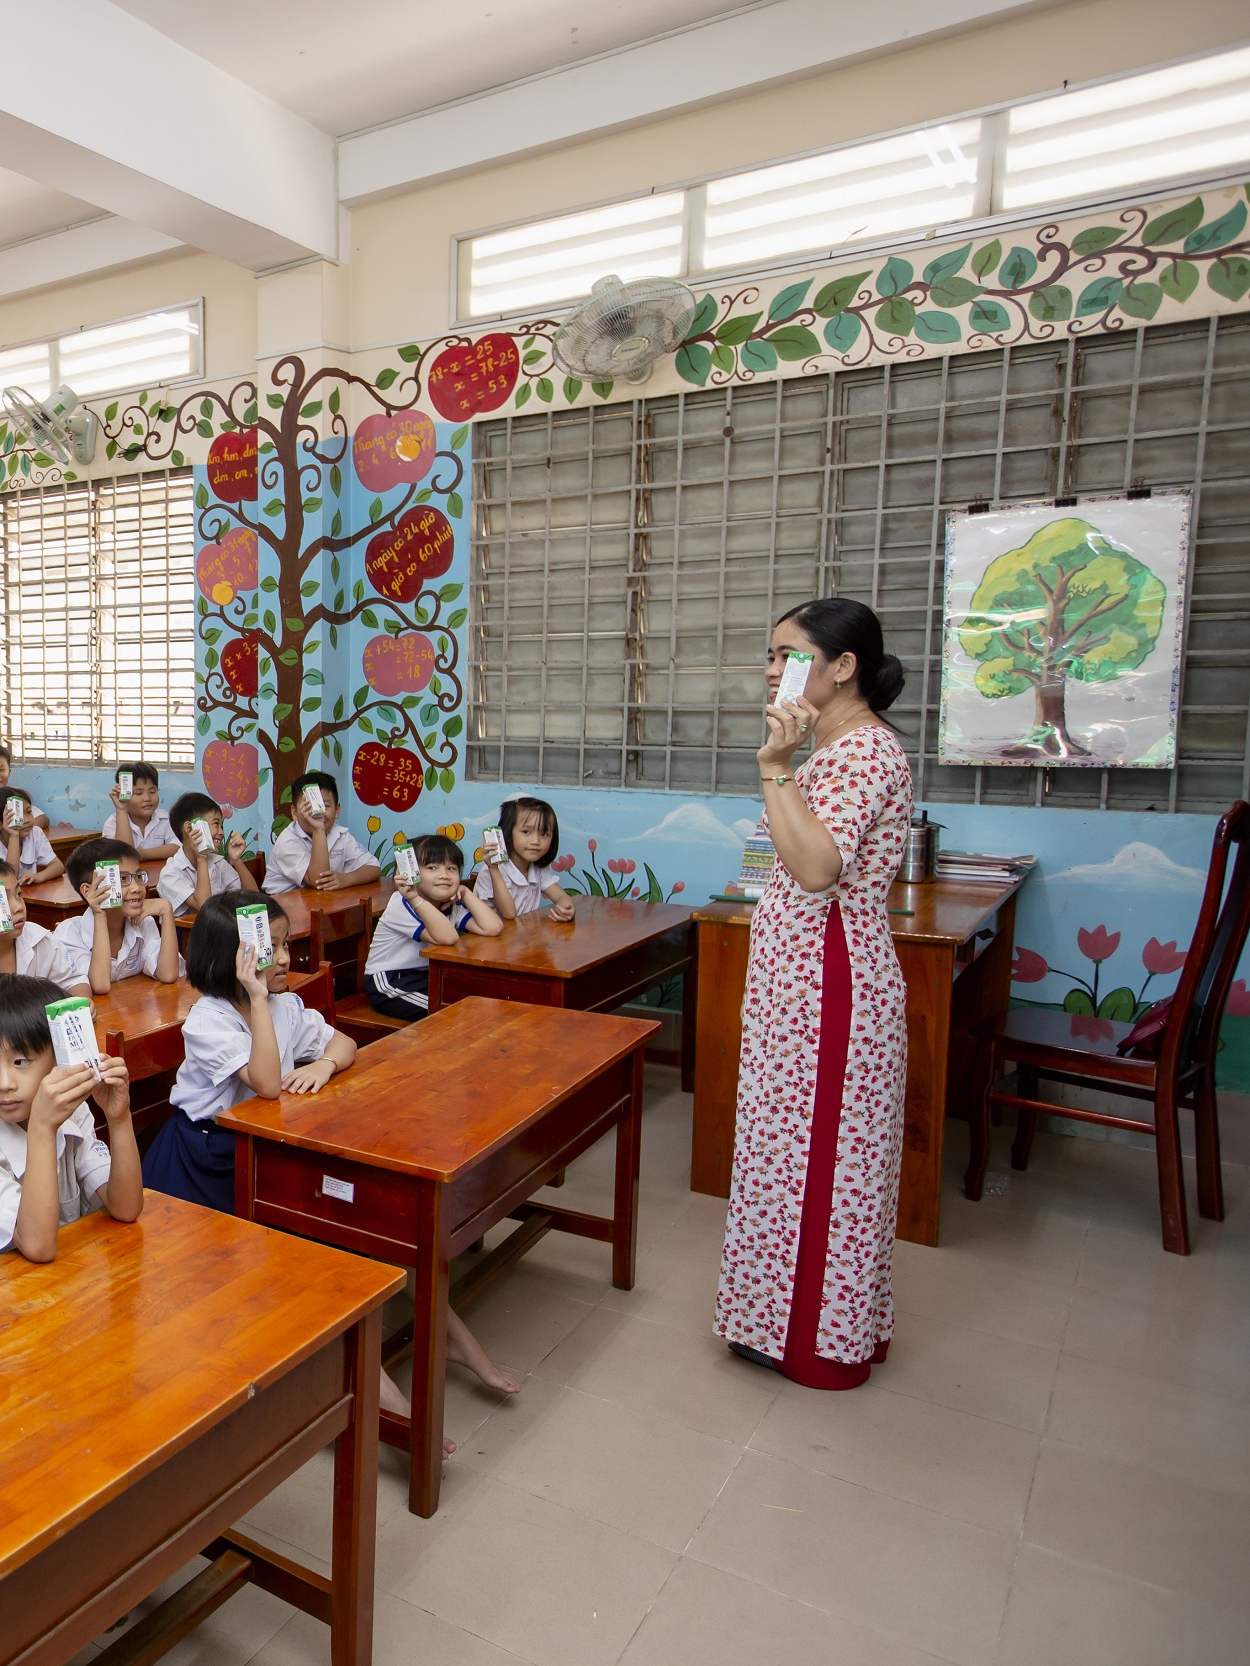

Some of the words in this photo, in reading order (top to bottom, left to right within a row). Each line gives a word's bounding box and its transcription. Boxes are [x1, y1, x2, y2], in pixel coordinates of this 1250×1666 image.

[476, 340, 493, 359] 25
[372, 547, 399, 572] ngày
[404, 522, 419, 540] 24
[419, 543, 433, 562] 60
[398, 758, 412, 771] 35
[393, 785, 408, 801] 63
